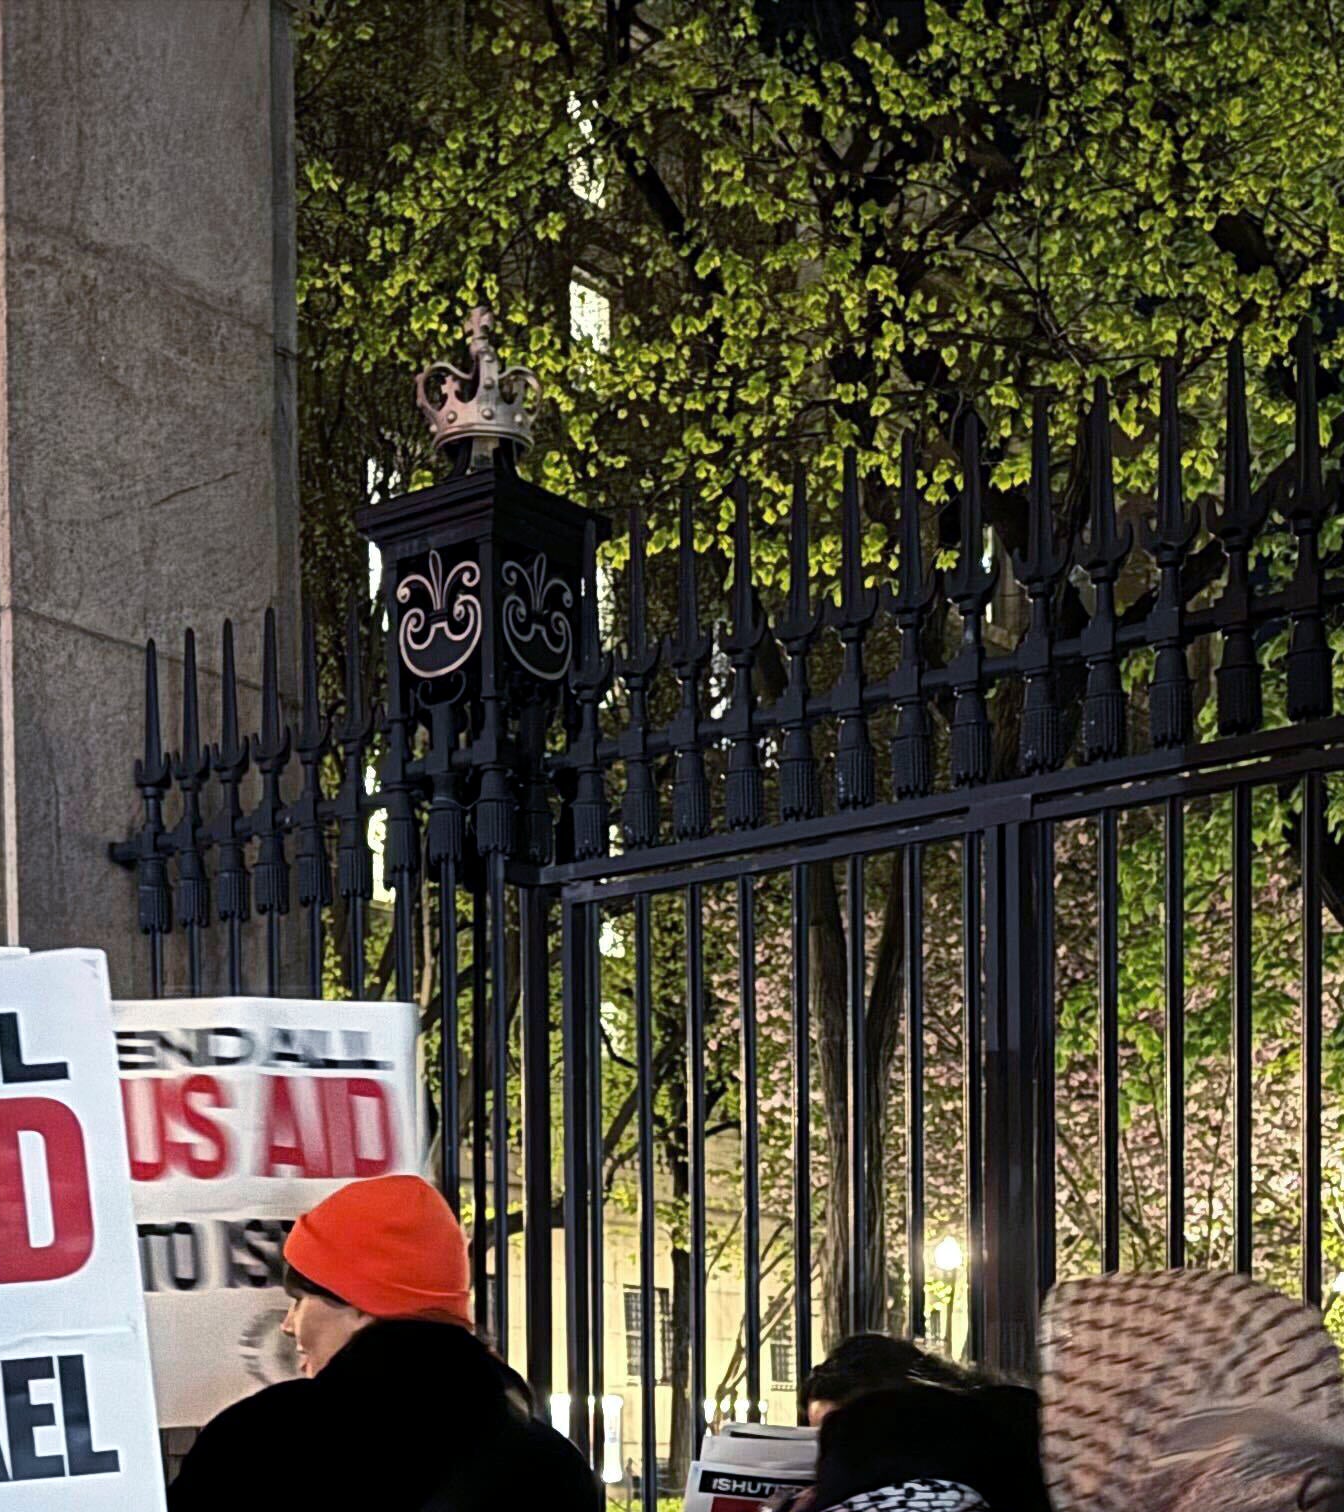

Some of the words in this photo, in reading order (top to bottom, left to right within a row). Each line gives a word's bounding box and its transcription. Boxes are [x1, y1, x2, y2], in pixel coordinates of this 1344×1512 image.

[115, 1026, 256, 1070] END
[271, 1027, 395, 1071] ALL
[120, 1074, 234, 1182] US
[255, 1075, 400, 1179] AID
